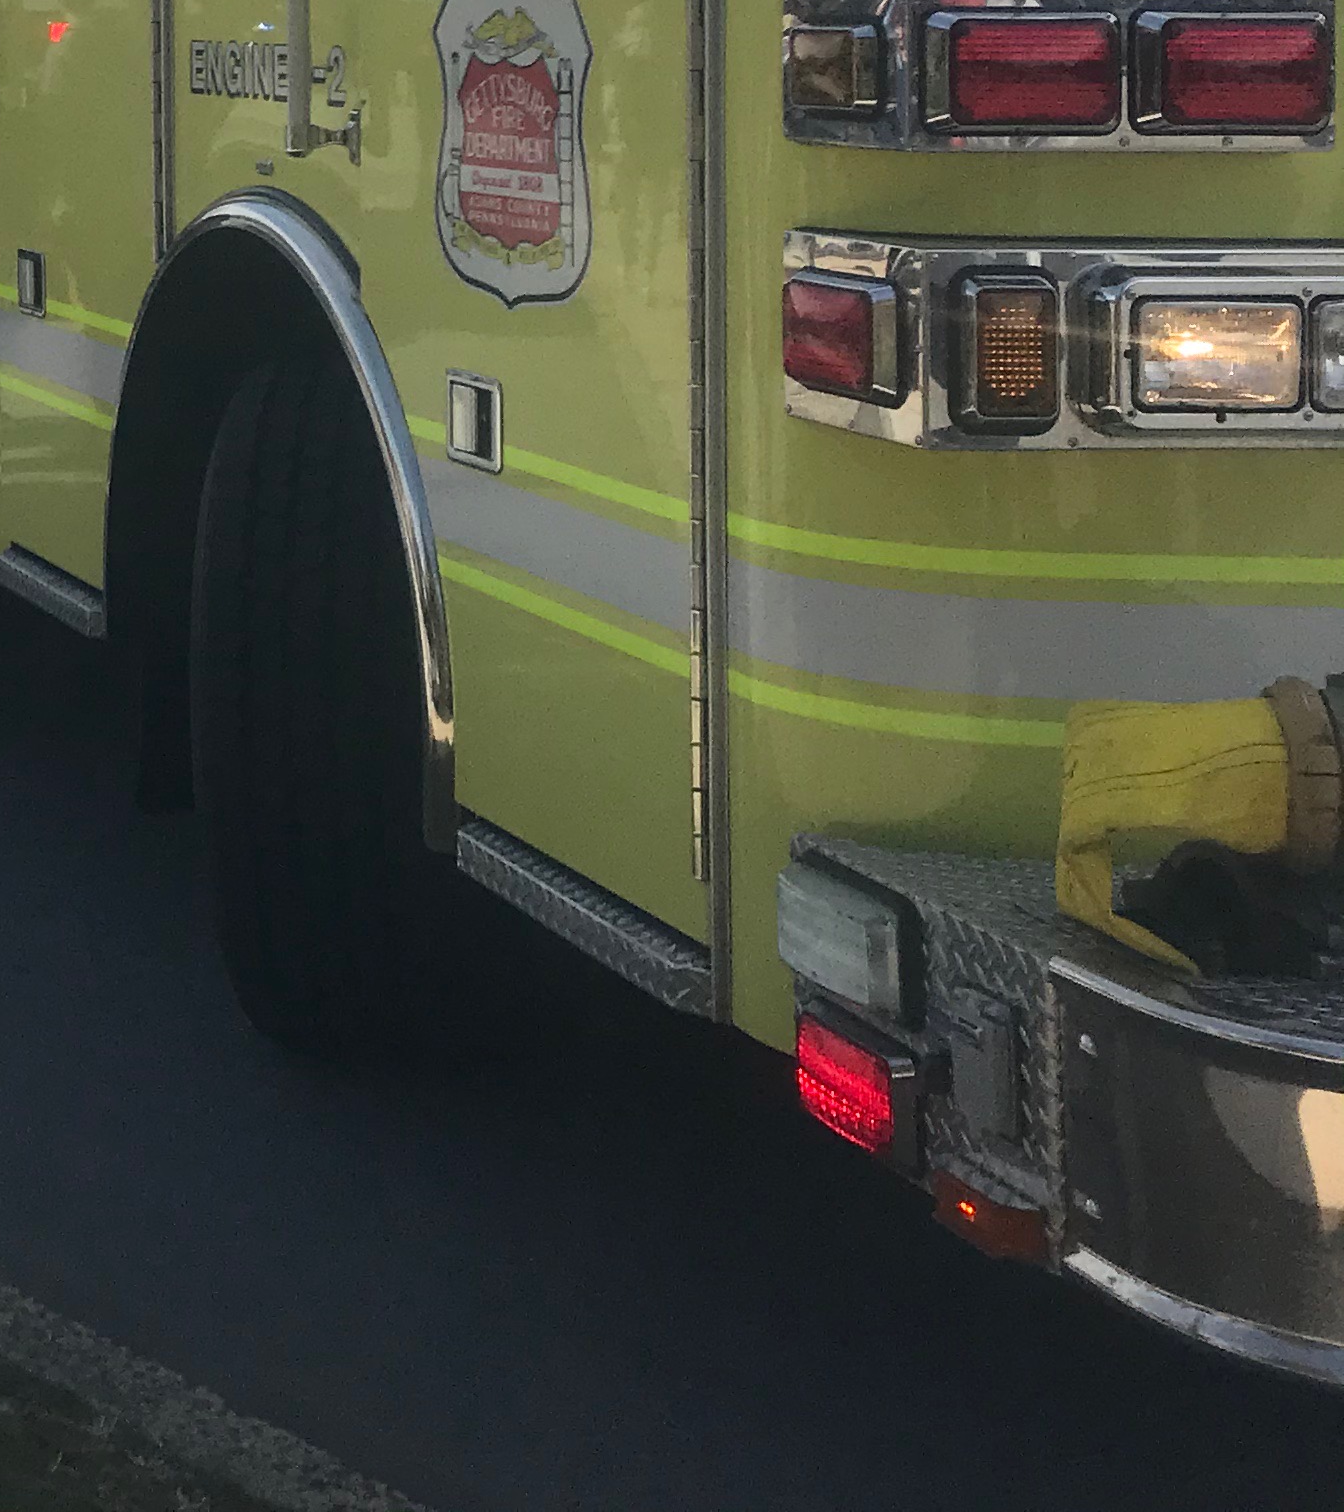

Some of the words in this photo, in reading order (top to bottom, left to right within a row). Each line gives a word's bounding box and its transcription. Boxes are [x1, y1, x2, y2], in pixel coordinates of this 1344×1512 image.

[464, 73, 554, 131] GETTYSBURG
[491, 104, 526, 131] FIRE
[465, 131, 553, 163] DEPARTMENT
